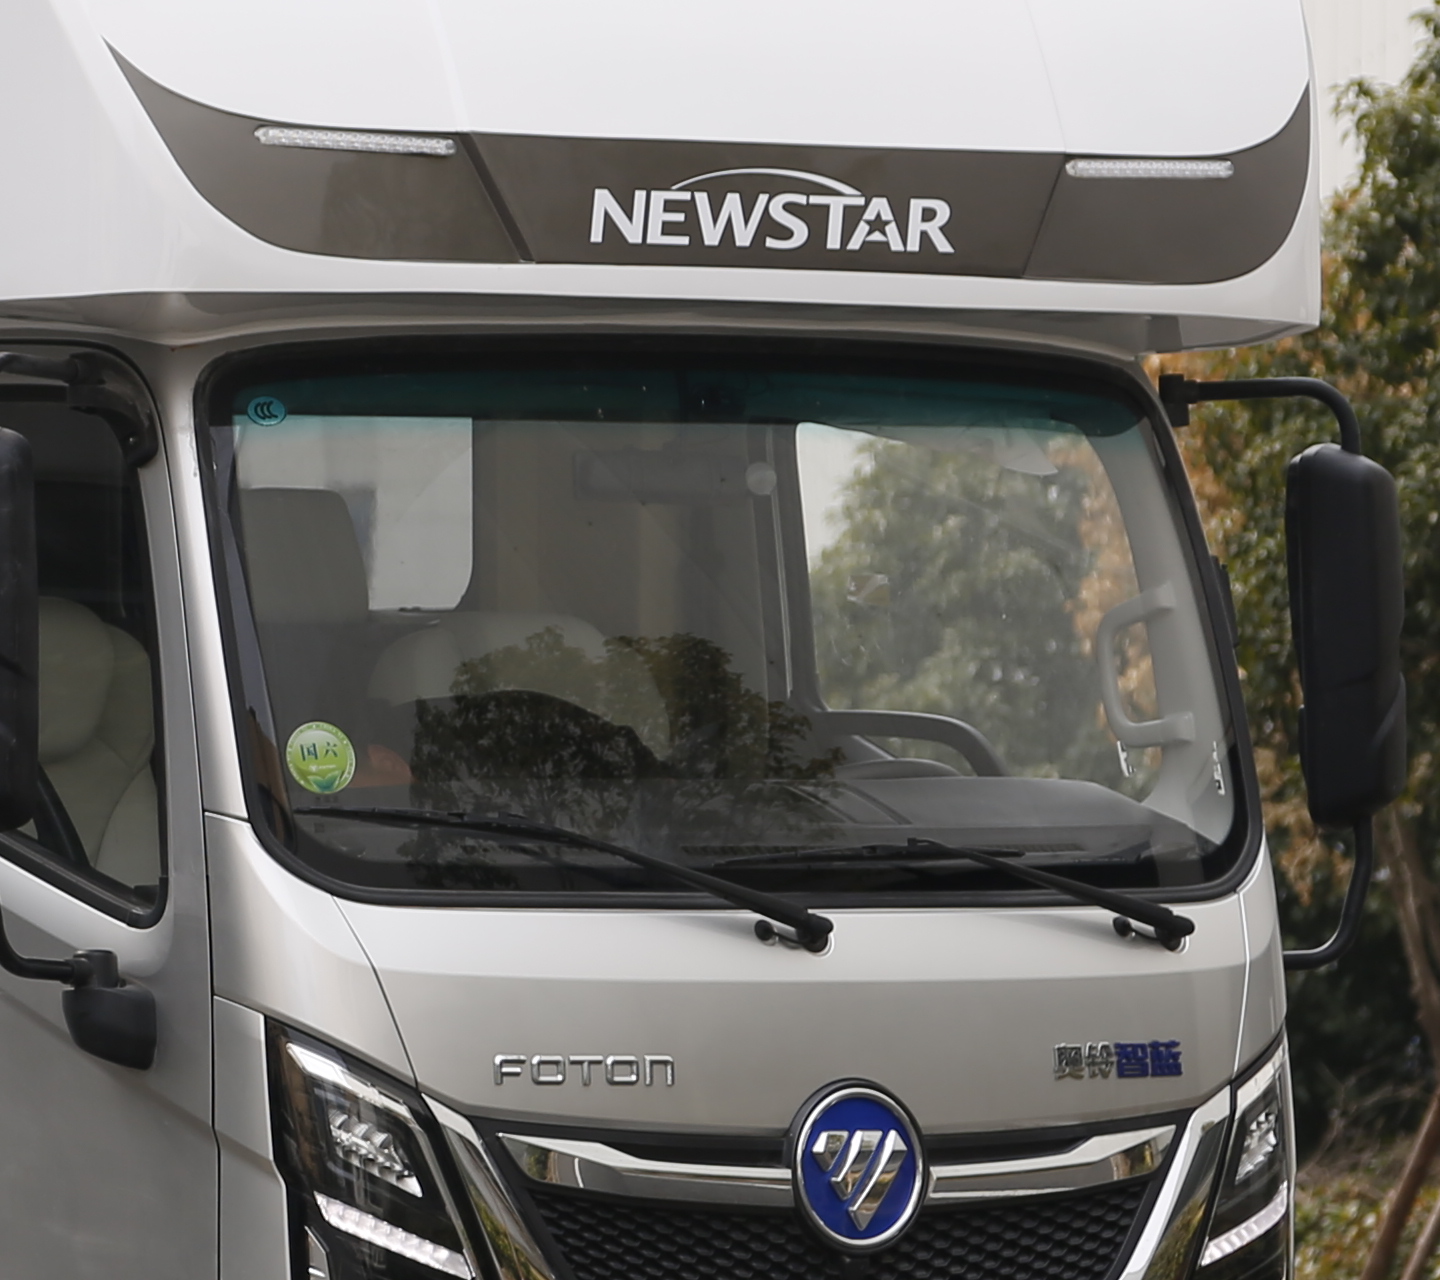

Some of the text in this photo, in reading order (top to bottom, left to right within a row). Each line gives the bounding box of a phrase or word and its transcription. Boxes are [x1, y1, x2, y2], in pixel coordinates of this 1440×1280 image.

[589, 188, 956, 254] NEWSTAR
[299, 740, 339, 762] 国六
[492, 1053, 676, 1087] FOTON
